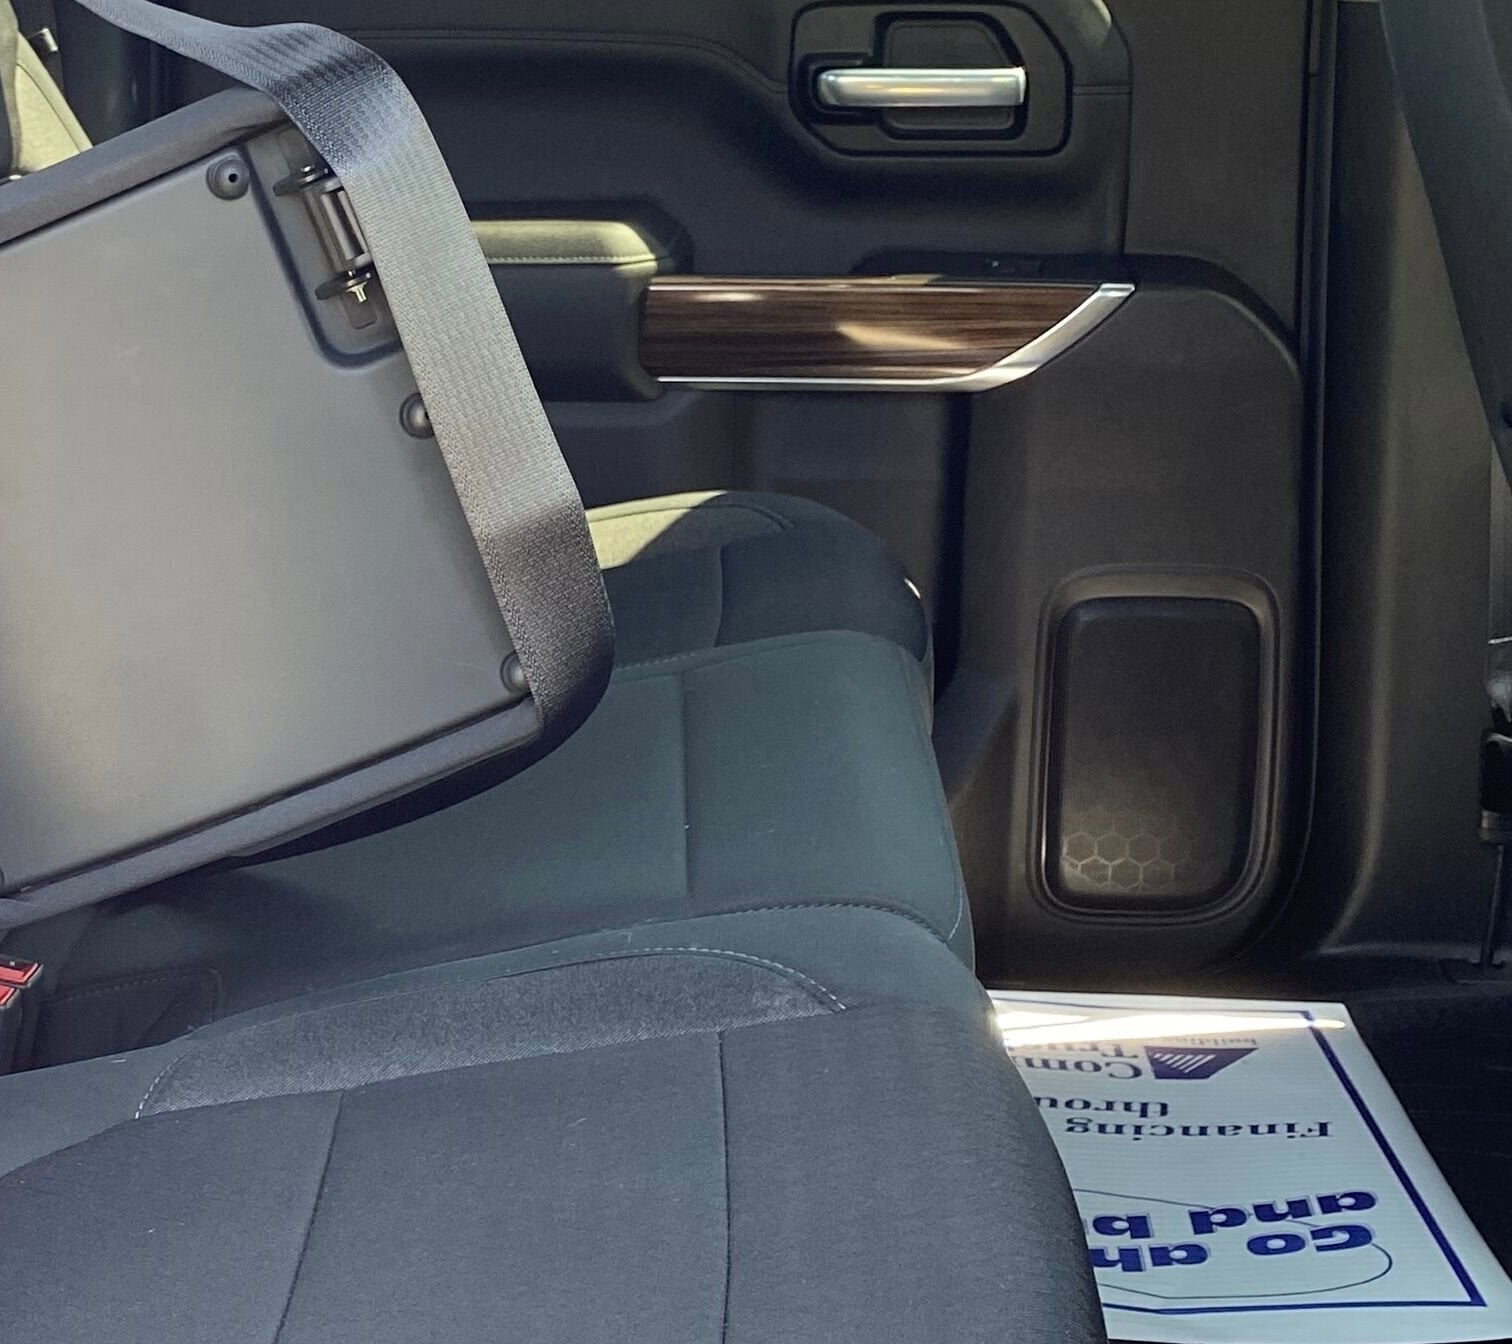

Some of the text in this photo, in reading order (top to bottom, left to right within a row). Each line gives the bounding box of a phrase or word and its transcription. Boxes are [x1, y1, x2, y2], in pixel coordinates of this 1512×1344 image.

[1065, 1116, 1333, 1142] Financing
[1188, 1190, 1376, 1236] and
[1246, 1224, 1375, 1257] Go
